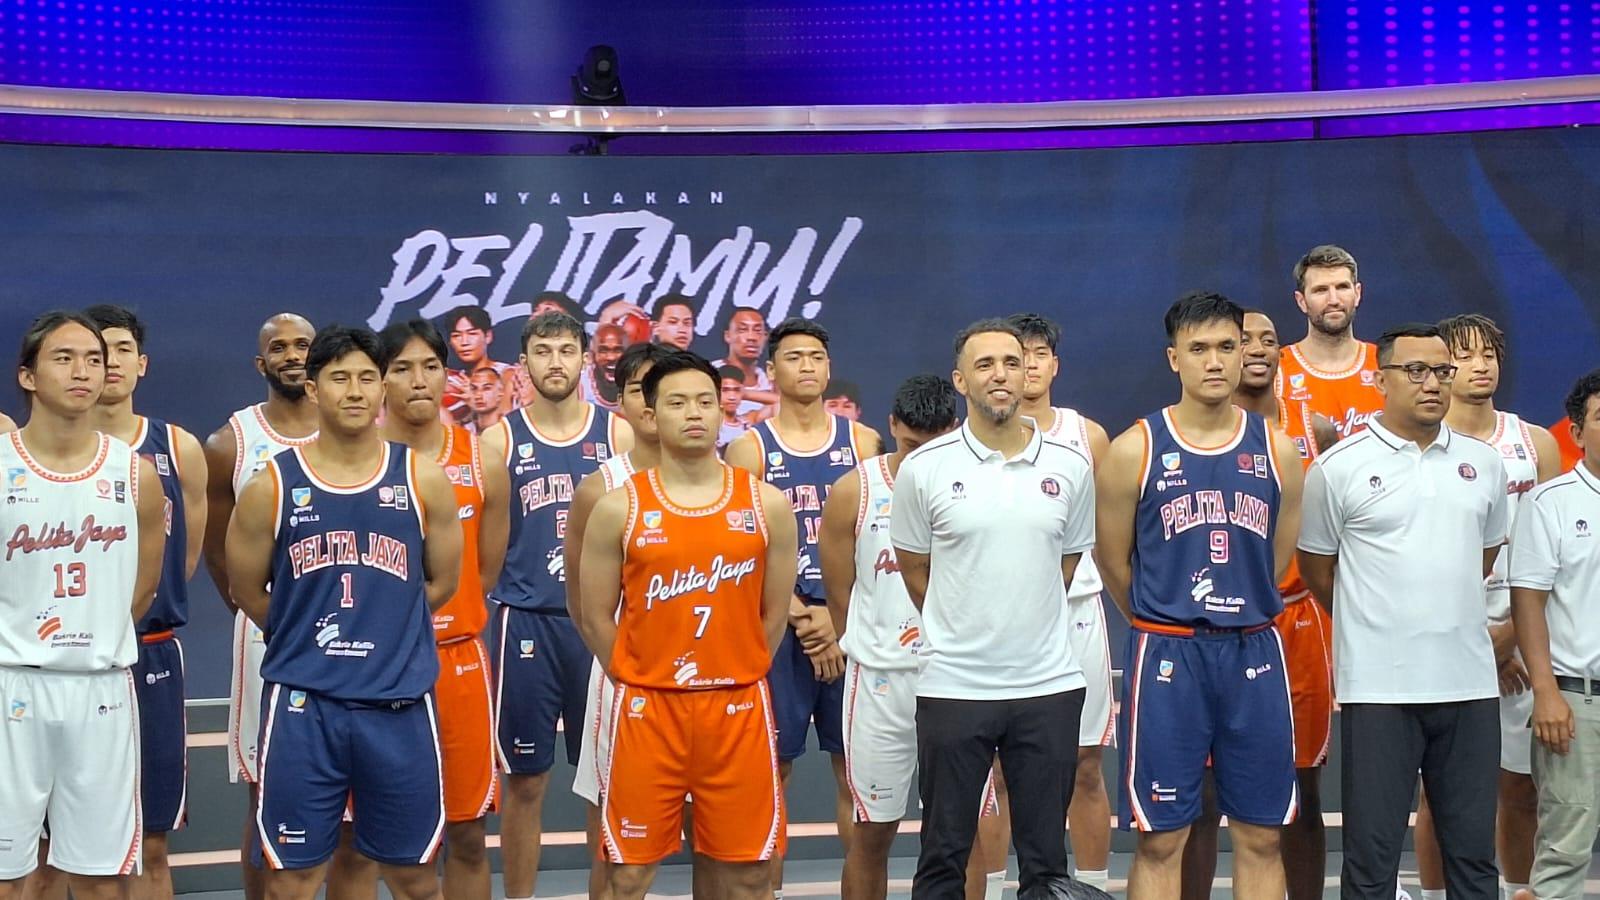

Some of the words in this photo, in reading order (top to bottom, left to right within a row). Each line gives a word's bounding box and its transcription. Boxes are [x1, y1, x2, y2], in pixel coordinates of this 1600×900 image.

[519, 473, 575, 518] PELITA
[1160, 490, 1227, 541] PELITA
[1229, 491, 1269, 541] JAYA
[6, 522, 74, 562] Pelita
[74, 513, 127, 554] Jaya
[289, 531, 359, 580] PELITA
[361, 531, 408, 581] JAYA
[1209, 530, 1229, 564] 9
[53, 561, 88, 598] 13
[340, 572, 354, 608] 1
[645, 564, 707, 610] Pelita
[707, 554, 756, 593] Jaya
[694, 605, 712, 639] 7
